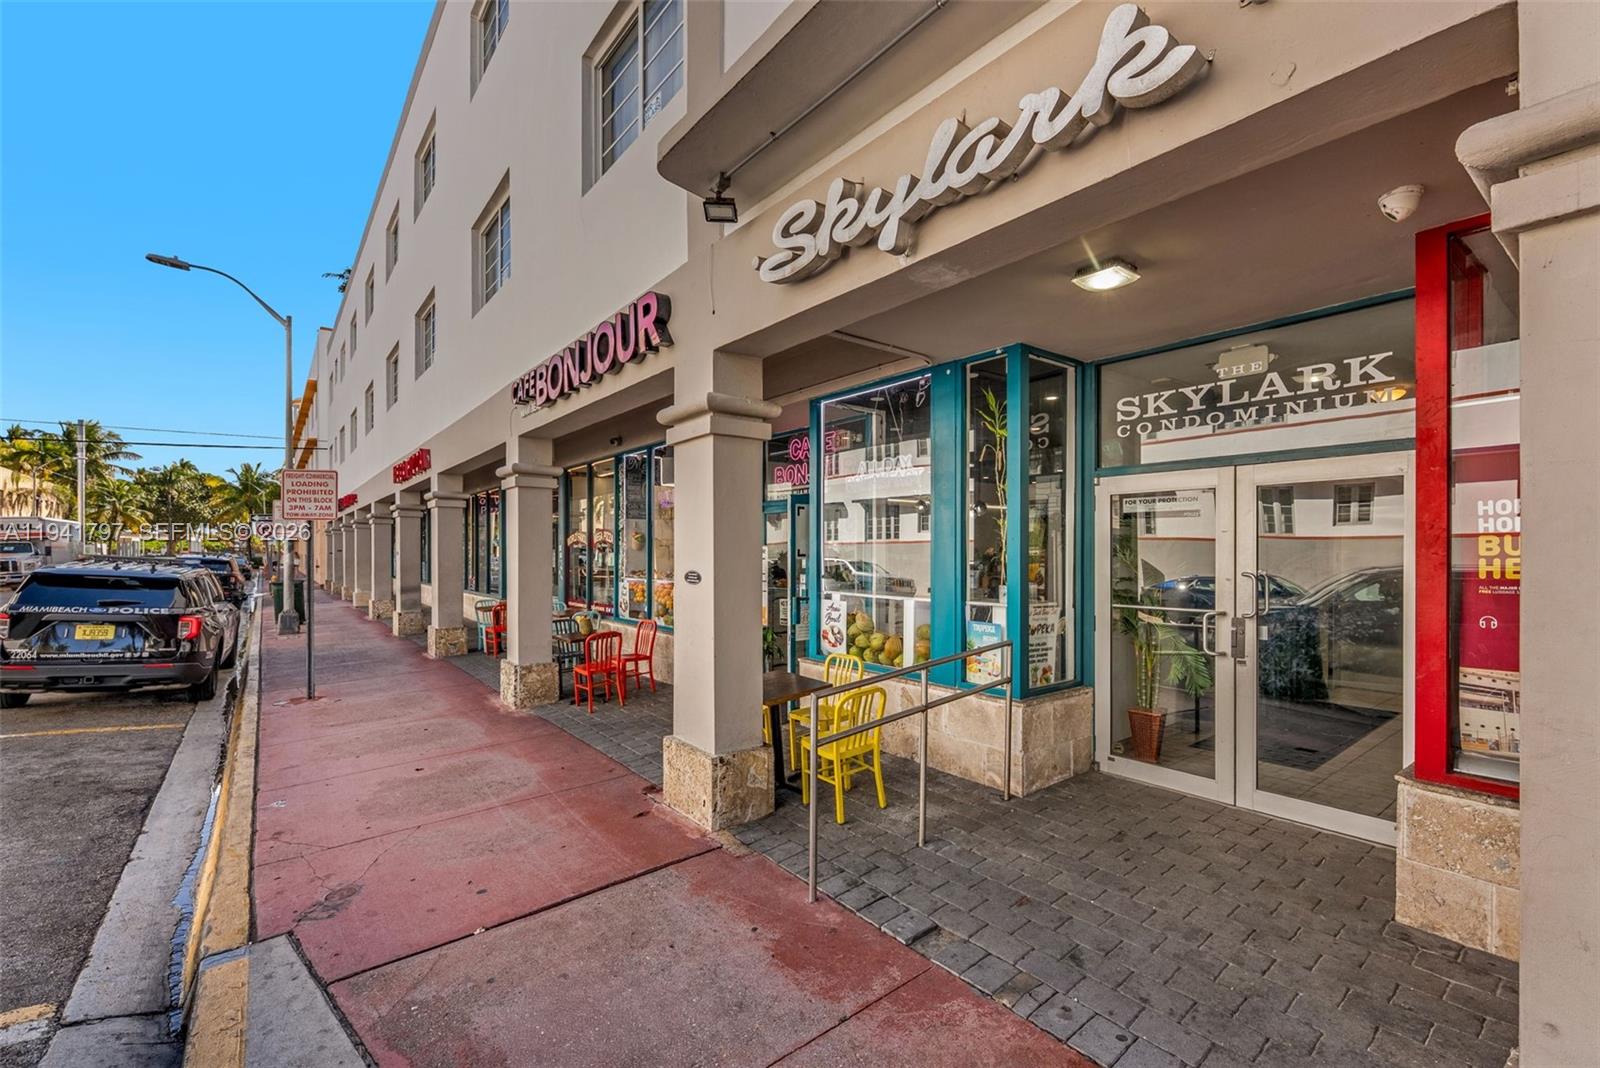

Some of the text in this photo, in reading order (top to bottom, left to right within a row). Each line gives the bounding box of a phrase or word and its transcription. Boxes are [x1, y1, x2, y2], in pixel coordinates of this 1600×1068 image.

[754, 3, 1202, 284] Skylark
[512, 291, 668, 408] CAFE BONJOUR
[1216, 361, 1263, 377] THE
[1116, 352, 1396, 422] SKYLARK
[1117, 387, 1396, 438] CONDOMINIUM
[789, 431, 837, 461] CAE
[108, 607, 169, 615] POLICE
[10, 650, 37, 659] 22064
